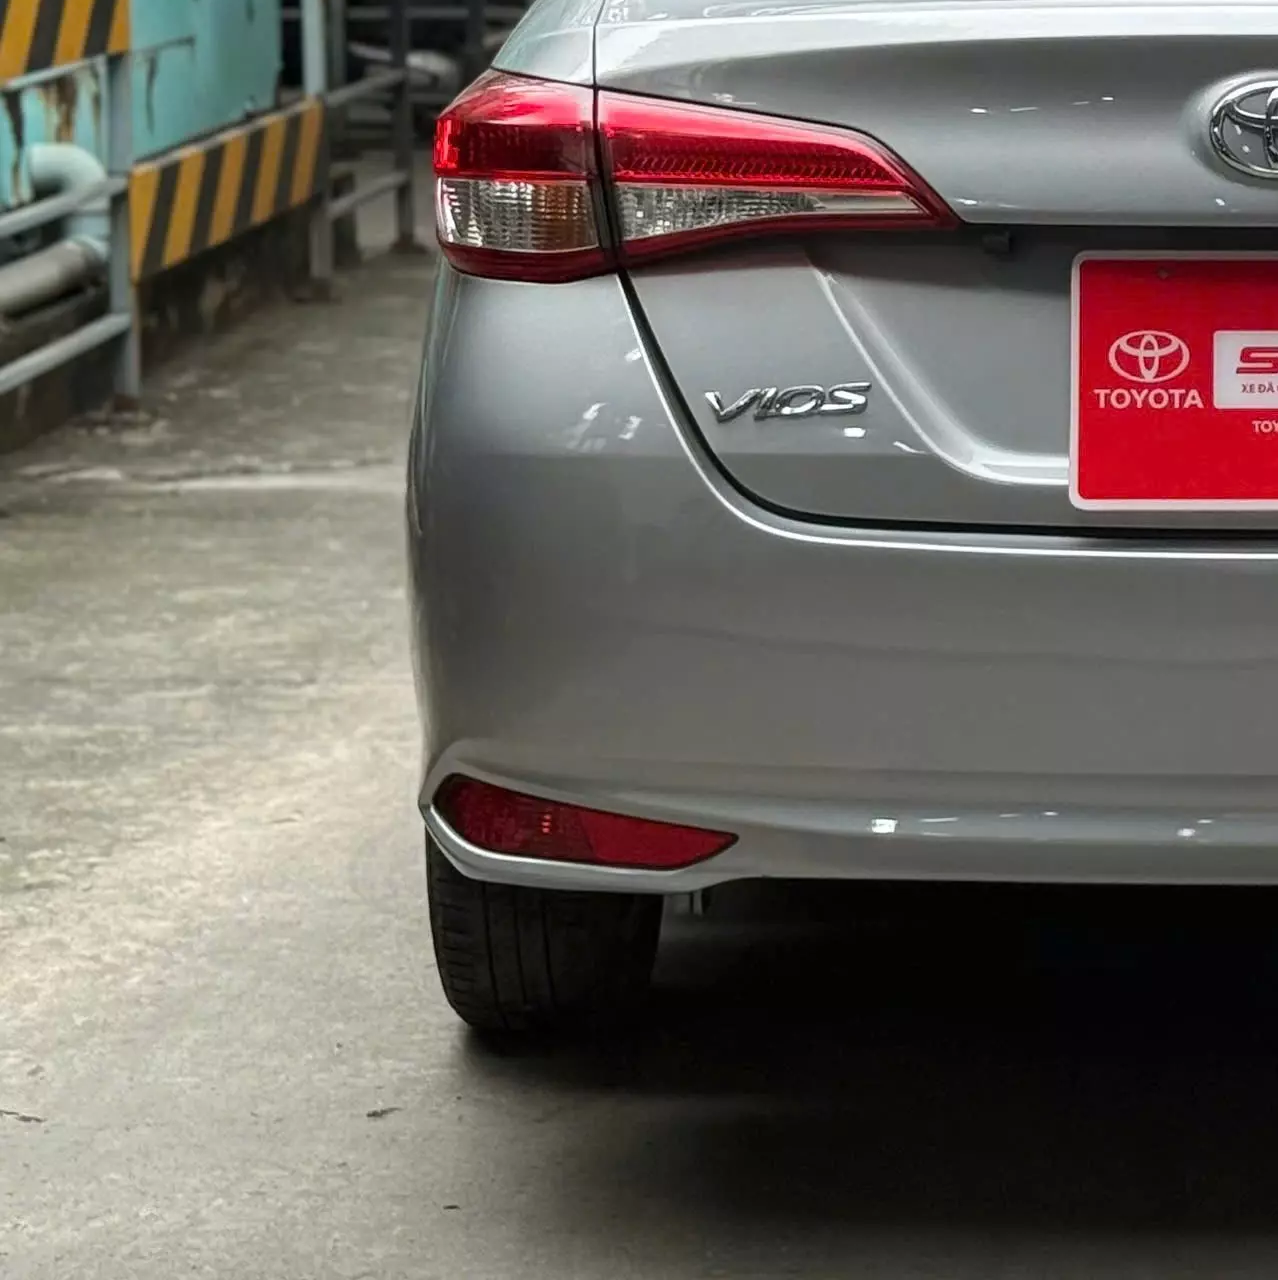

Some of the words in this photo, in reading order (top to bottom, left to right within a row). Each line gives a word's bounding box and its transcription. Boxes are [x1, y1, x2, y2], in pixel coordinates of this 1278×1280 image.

[1094, 388, 1204, 409] TOYOTA
[1241, 383, 1256, 394] XE
[704, 382, 872, 423] VIOS
